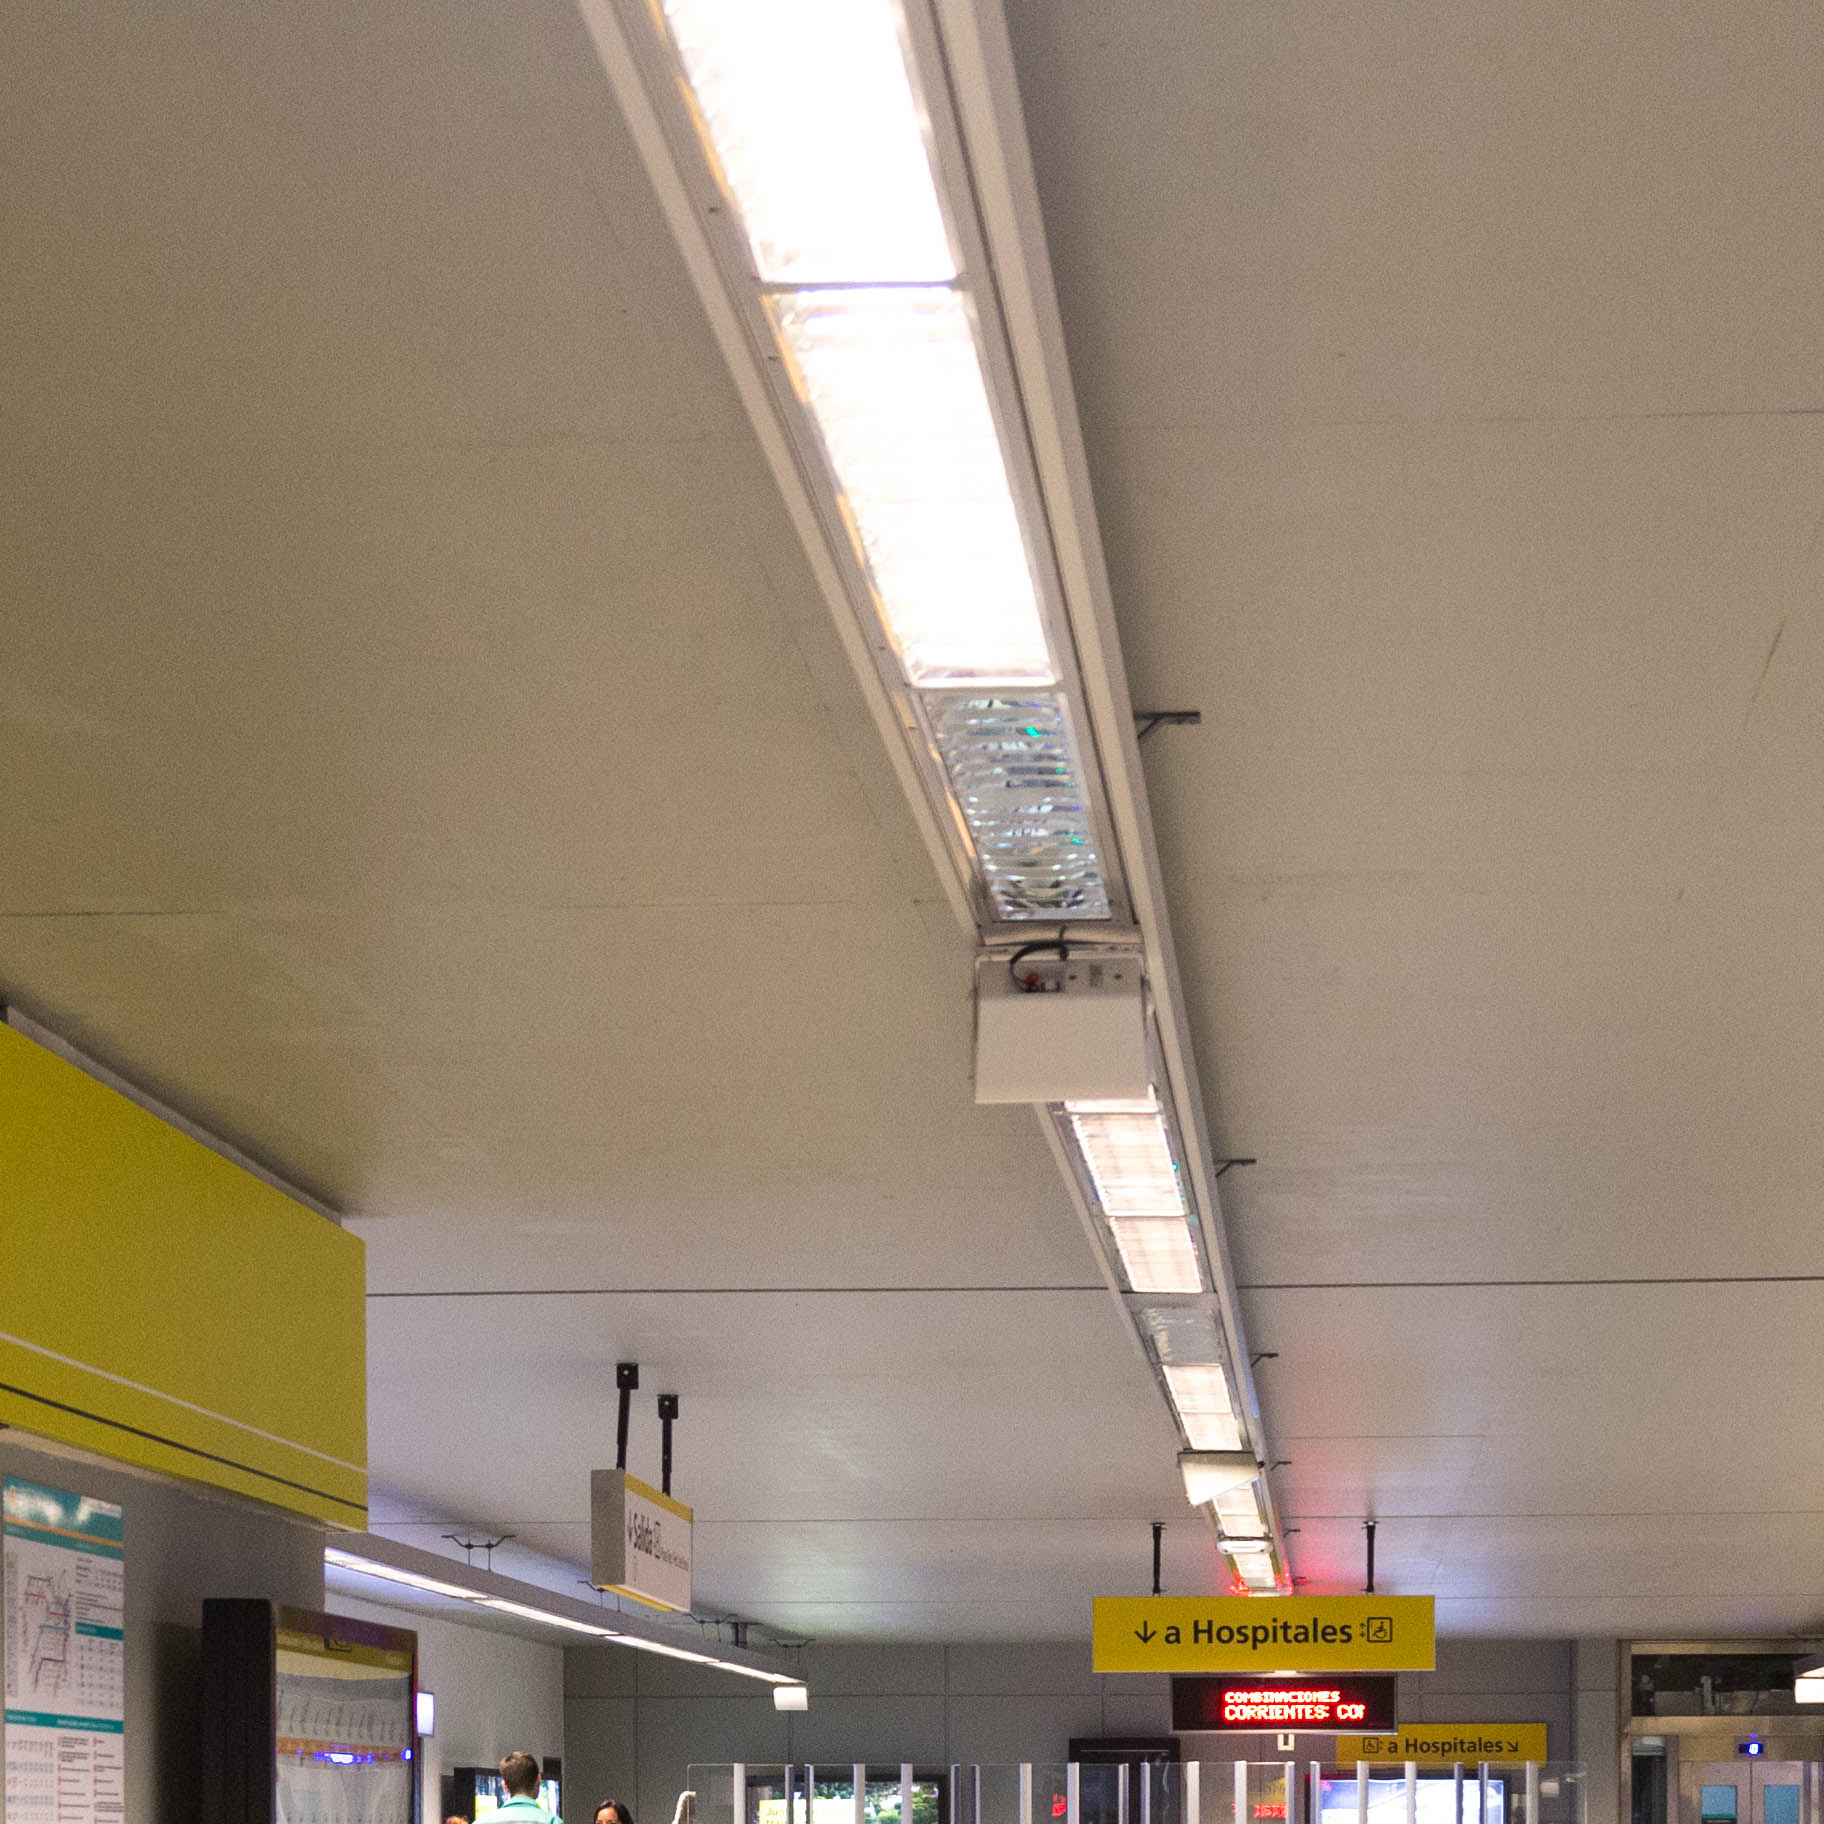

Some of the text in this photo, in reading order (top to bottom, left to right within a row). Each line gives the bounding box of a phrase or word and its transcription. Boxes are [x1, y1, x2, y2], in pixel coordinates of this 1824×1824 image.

[1163, 1617, 1354, 1650] a Hospitales
[1224, 1690, 1341, 1704] COMBINACIONES
[1224, 1704, 1331, 1721] CORRIENTES:
[1387, 1736, 1505, 1757] a Hospitales
